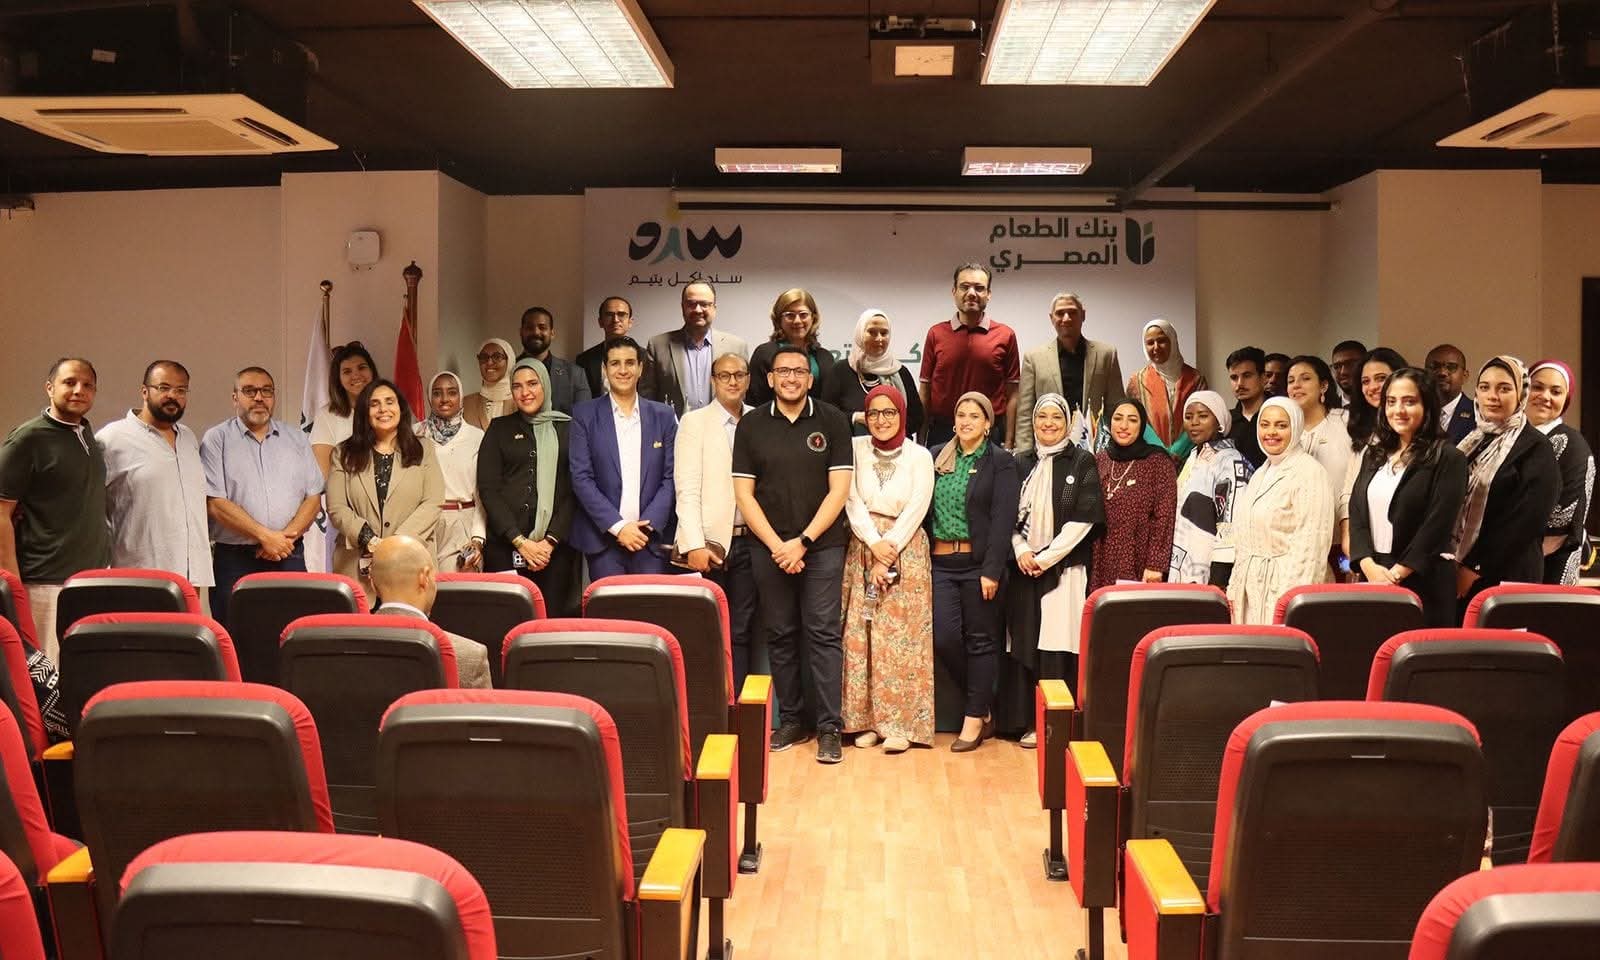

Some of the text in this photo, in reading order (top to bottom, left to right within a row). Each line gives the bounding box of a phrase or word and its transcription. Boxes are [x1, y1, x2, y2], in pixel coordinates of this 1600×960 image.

[989, 217, 1118, 243] بنك الطعام
[989, 244, 1118, 272] المصري
[628, 273, 663, 287] يتيم
